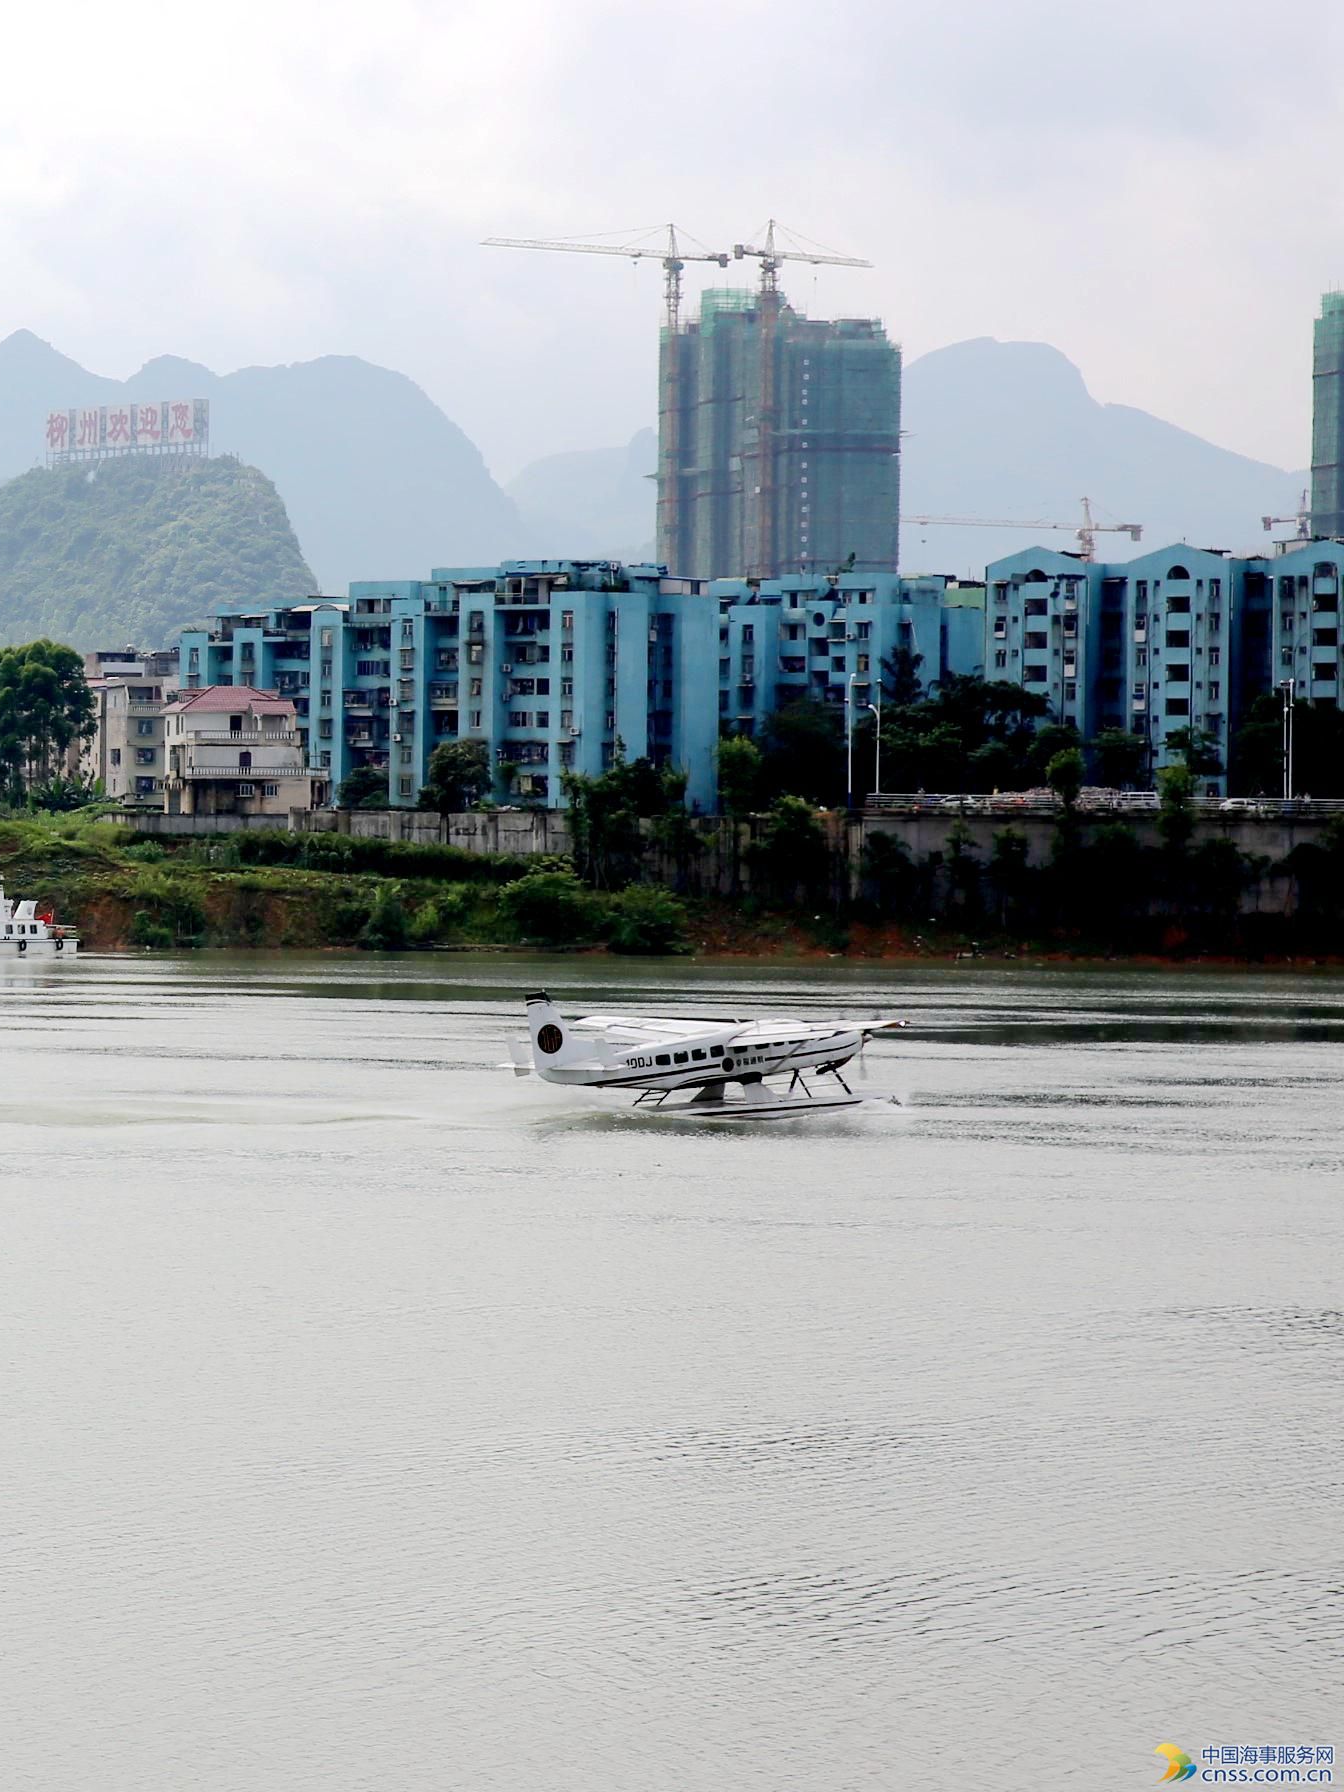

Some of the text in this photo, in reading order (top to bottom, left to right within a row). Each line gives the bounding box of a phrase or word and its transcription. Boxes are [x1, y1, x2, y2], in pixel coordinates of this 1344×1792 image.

[46, 402, 193, 448] 柳州欢迎您
